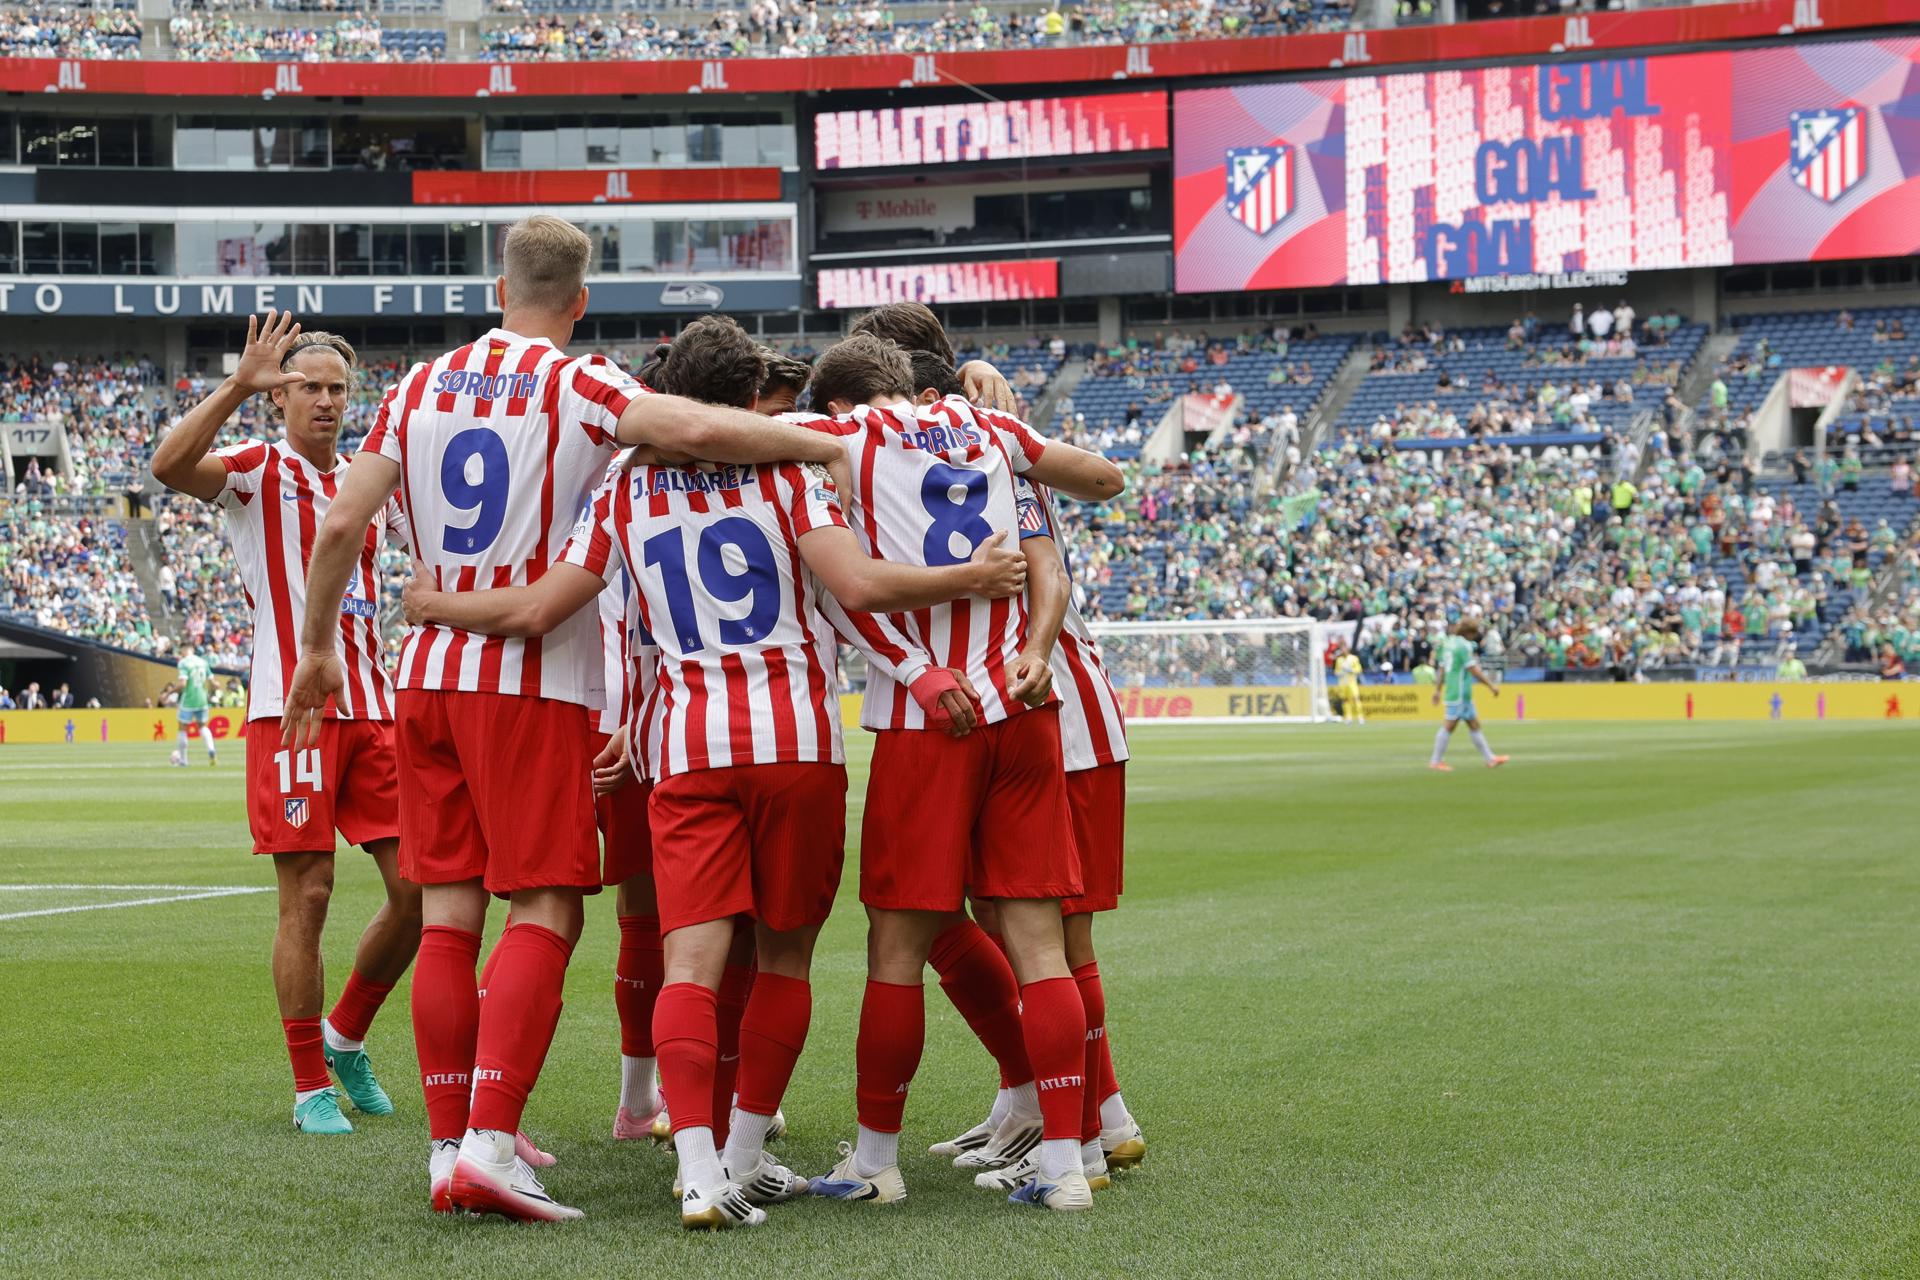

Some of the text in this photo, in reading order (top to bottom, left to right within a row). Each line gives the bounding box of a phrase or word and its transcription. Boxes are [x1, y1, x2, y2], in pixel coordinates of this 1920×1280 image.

[1540, 55, 1661, 121] GOAL
[1476, 134, 1596, 204] GOAL
[877, 199, 936, 218] Mobile
[1465, 271, 1629, 293] MITSUBISHI ELECTRIC
[0, 284, 502, 314] TO LUMEN FIEL
[433, 370, 539, 400] SØRLOTH
[12, 429, 50, 443] 117
[441, 427, 510, 555] 9
[653, 464, 755, 495] ALVAREZ
[921, 462, 994, 567] 8
[643, 516, 781, 655] 19
[359, 603, 374, 617] AIR
[1120, 687, 1194, 718] ive
[1229, 693, 1290, 716] FIFA
[273, 747, 323, 793] 14
[426, 1073, 468, 1087] ATLETI
[478, 1069, 502, 1080] LETI
[1040, 1076, 1081, 1090] ATLETI
